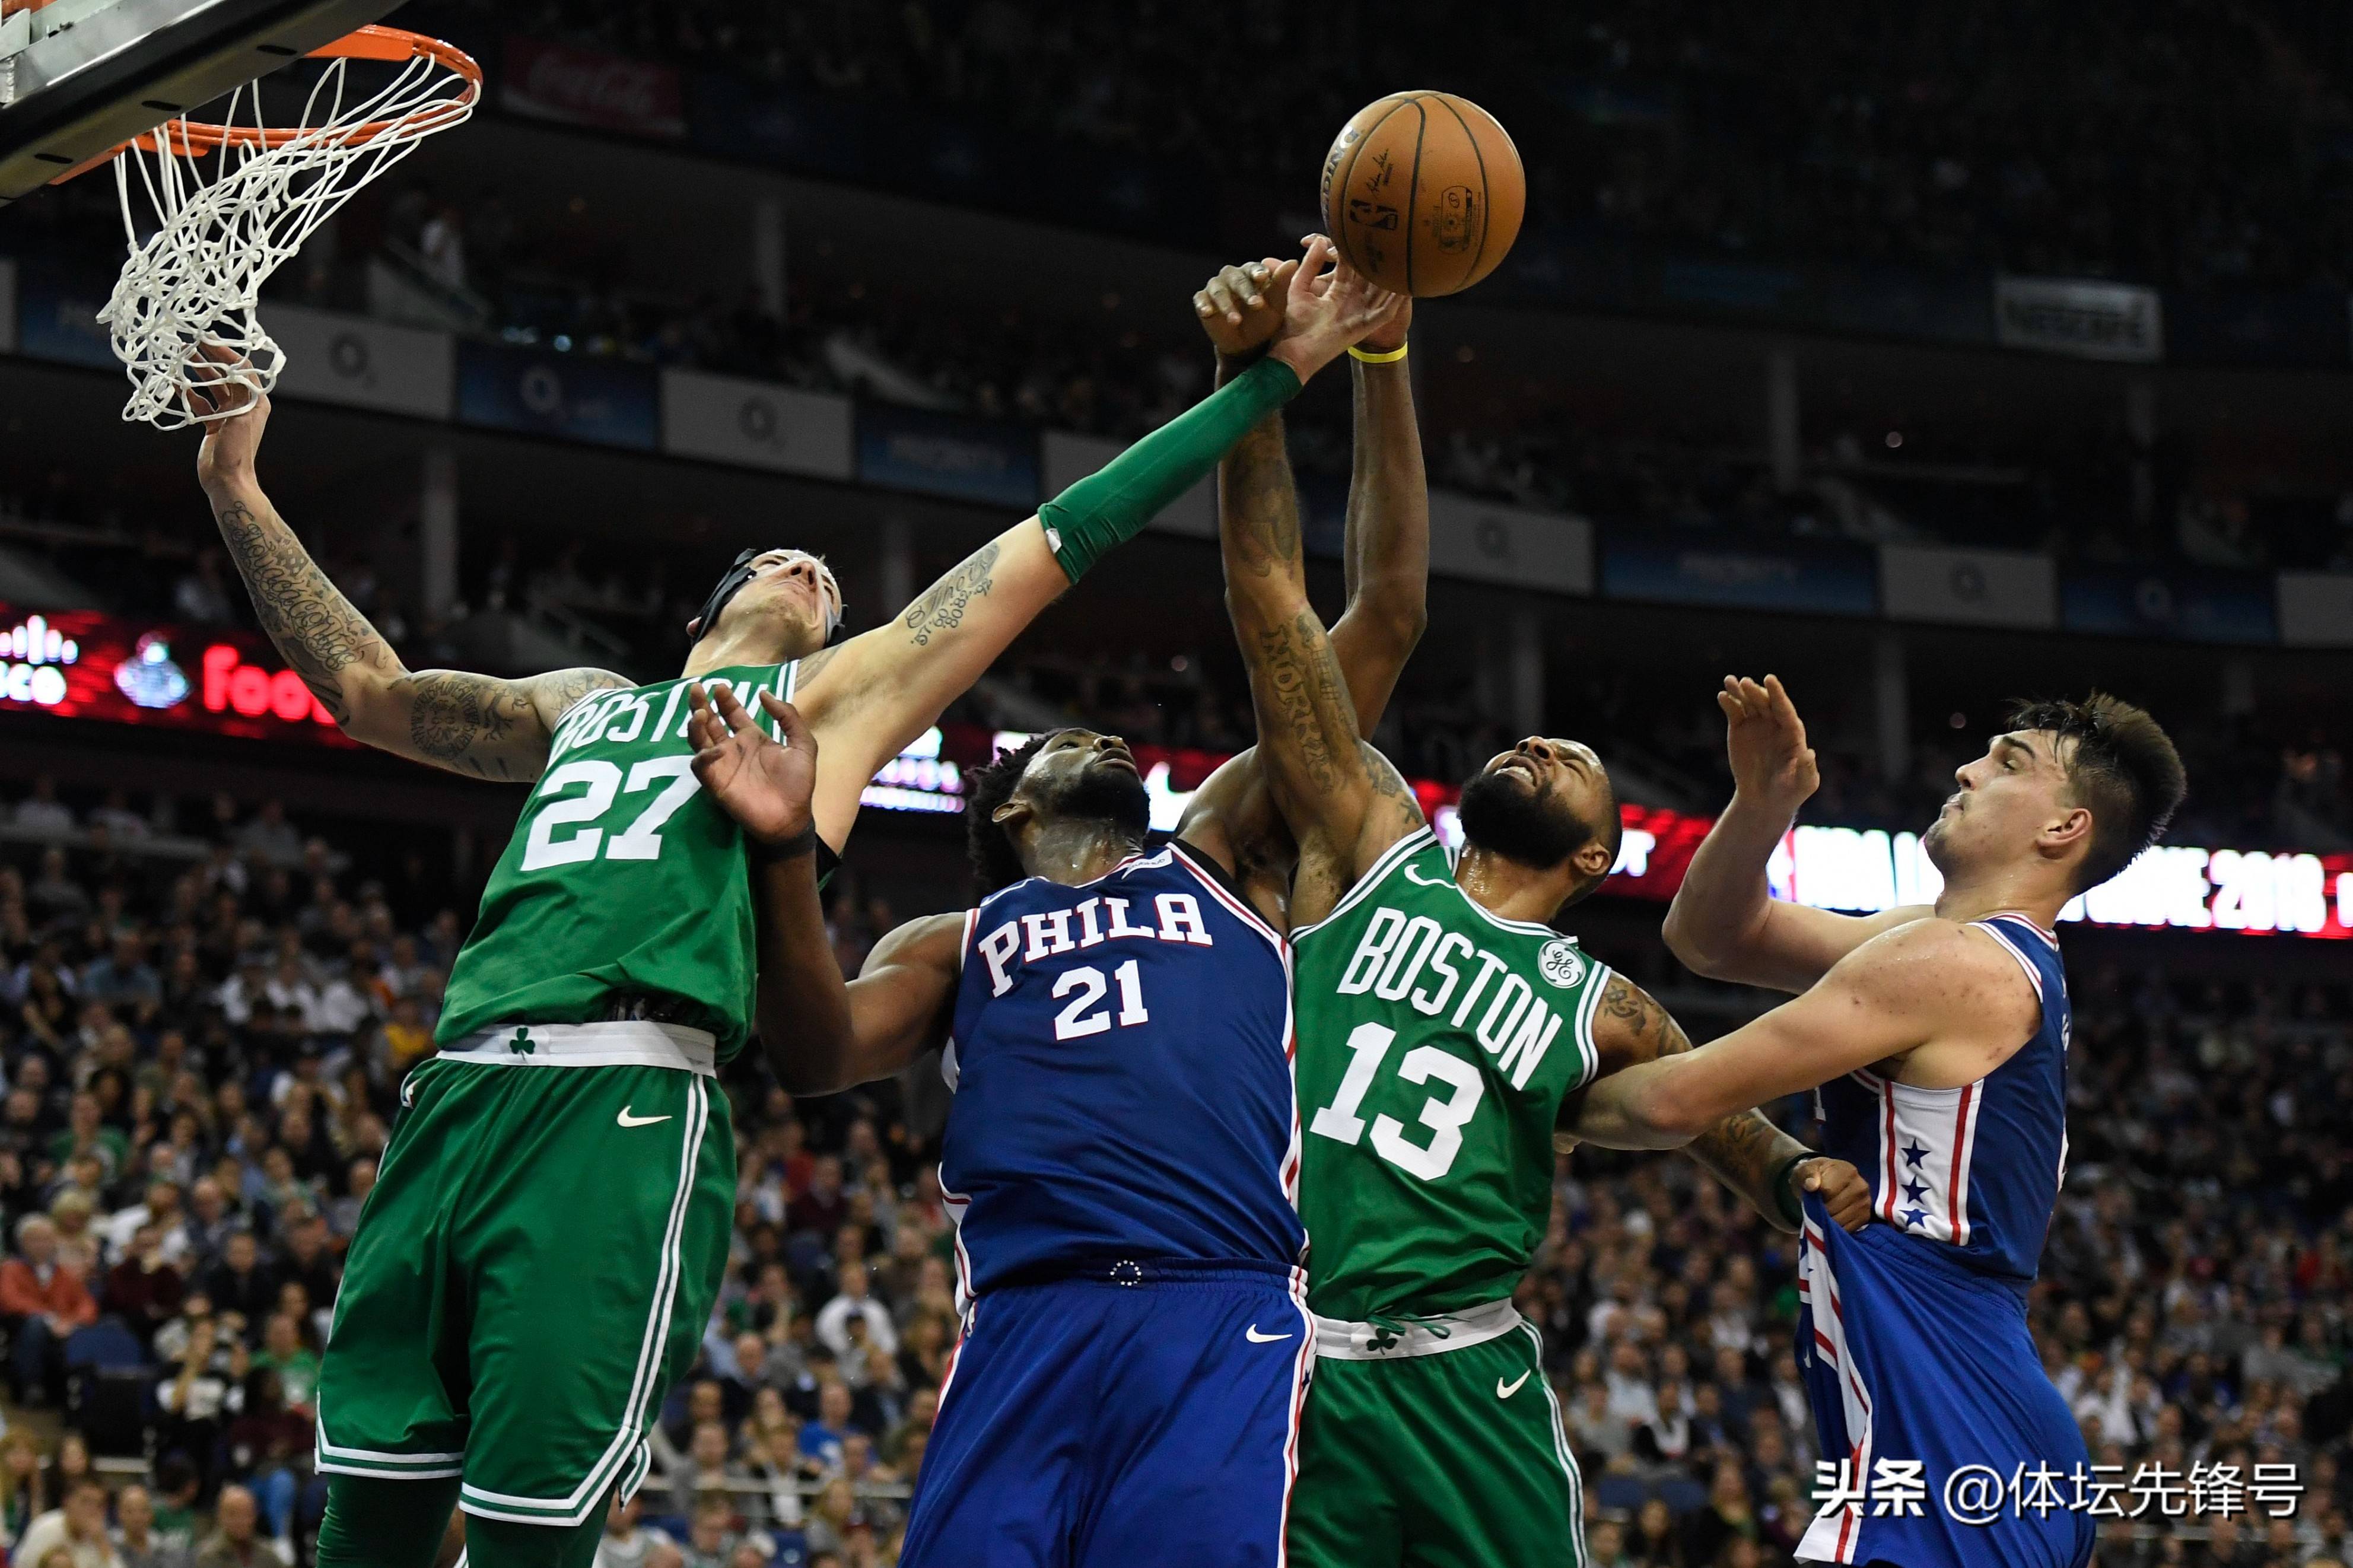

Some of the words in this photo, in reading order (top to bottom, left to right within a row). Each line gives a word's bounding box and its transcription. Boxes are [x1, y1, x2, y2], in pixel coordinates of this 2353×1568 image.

[203, 644, 336, 724] Foo
[520, 755, 702, 872] 27
[978, 893, 1213, 998] PHILA
[1051, 959, 1149, 1041] 21
[1336, 907, 1563, 1091] BOSTON
[1309, 1022, 1484, 1181] 13
